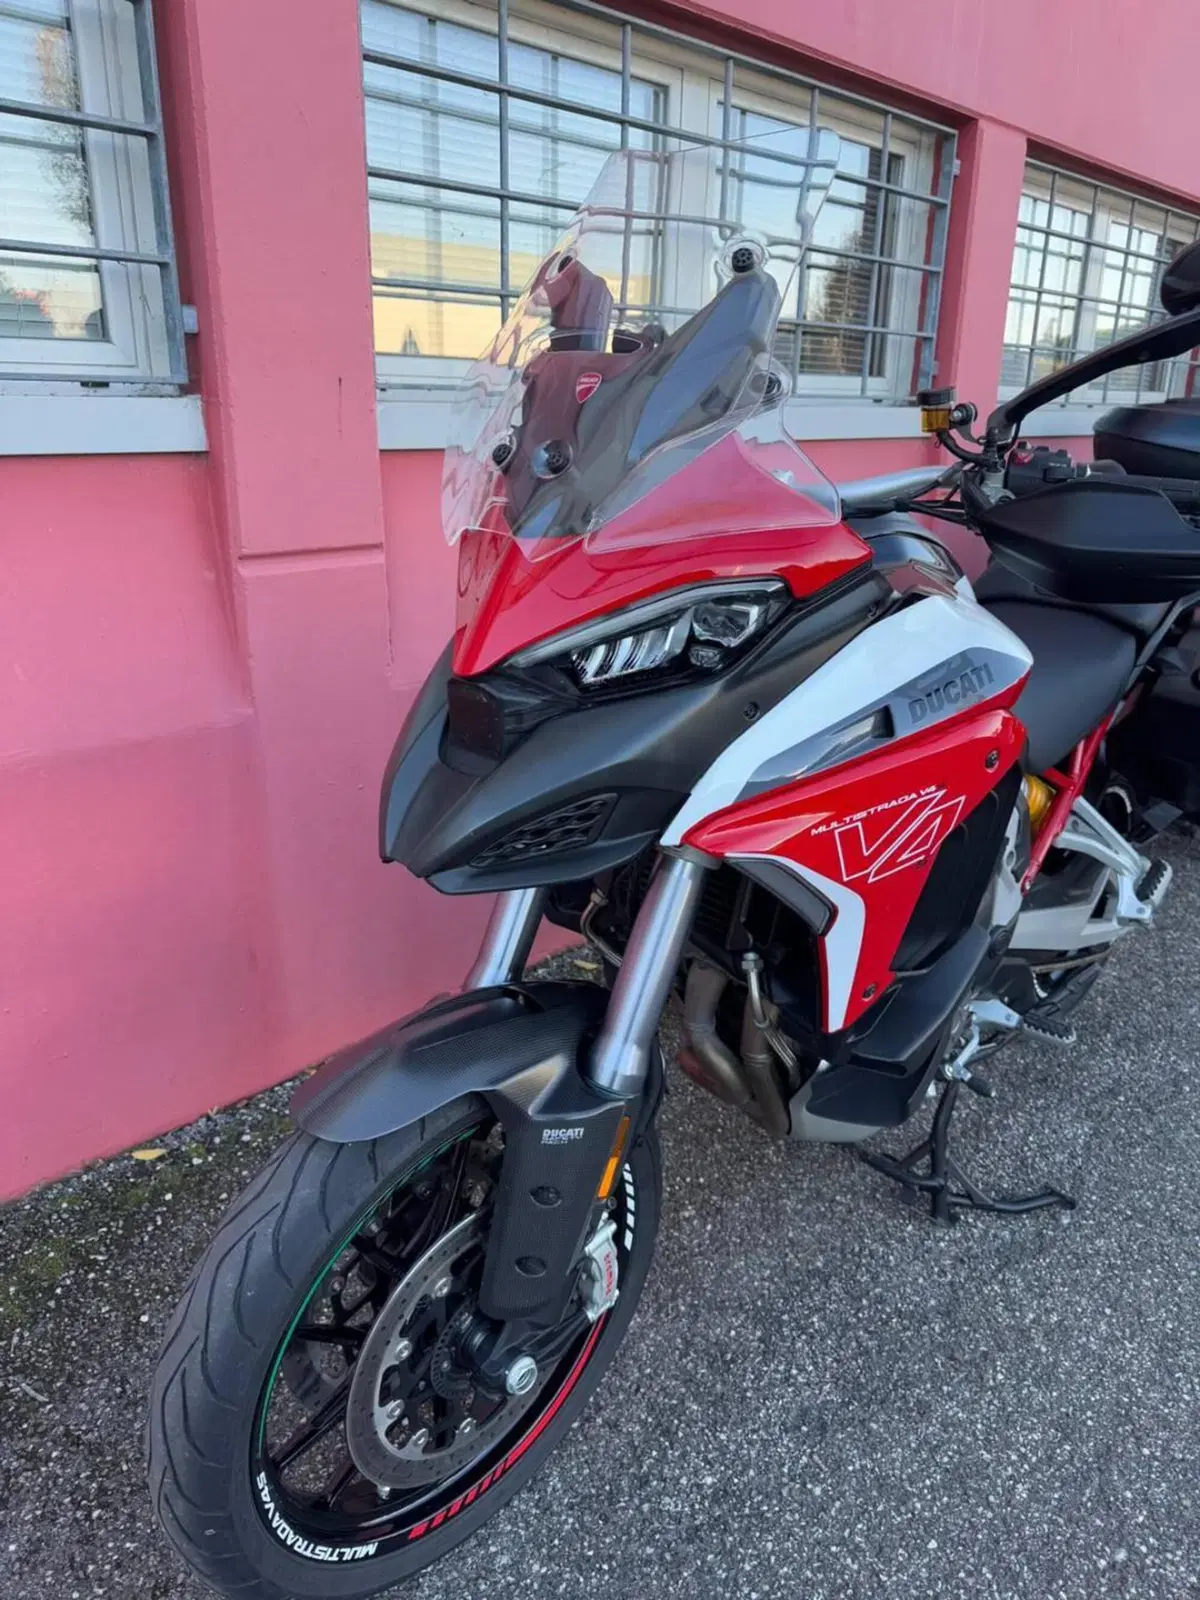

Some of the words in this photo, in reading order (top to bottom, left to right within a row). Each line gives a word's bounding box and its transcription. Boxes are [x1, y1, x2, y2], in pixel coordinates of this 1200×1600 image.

[908, 662, 995, 724] DUCATI
[810, 792, 919, 837] MULTISTRADA
[541, 1127, 584, 1140] DUCATI
